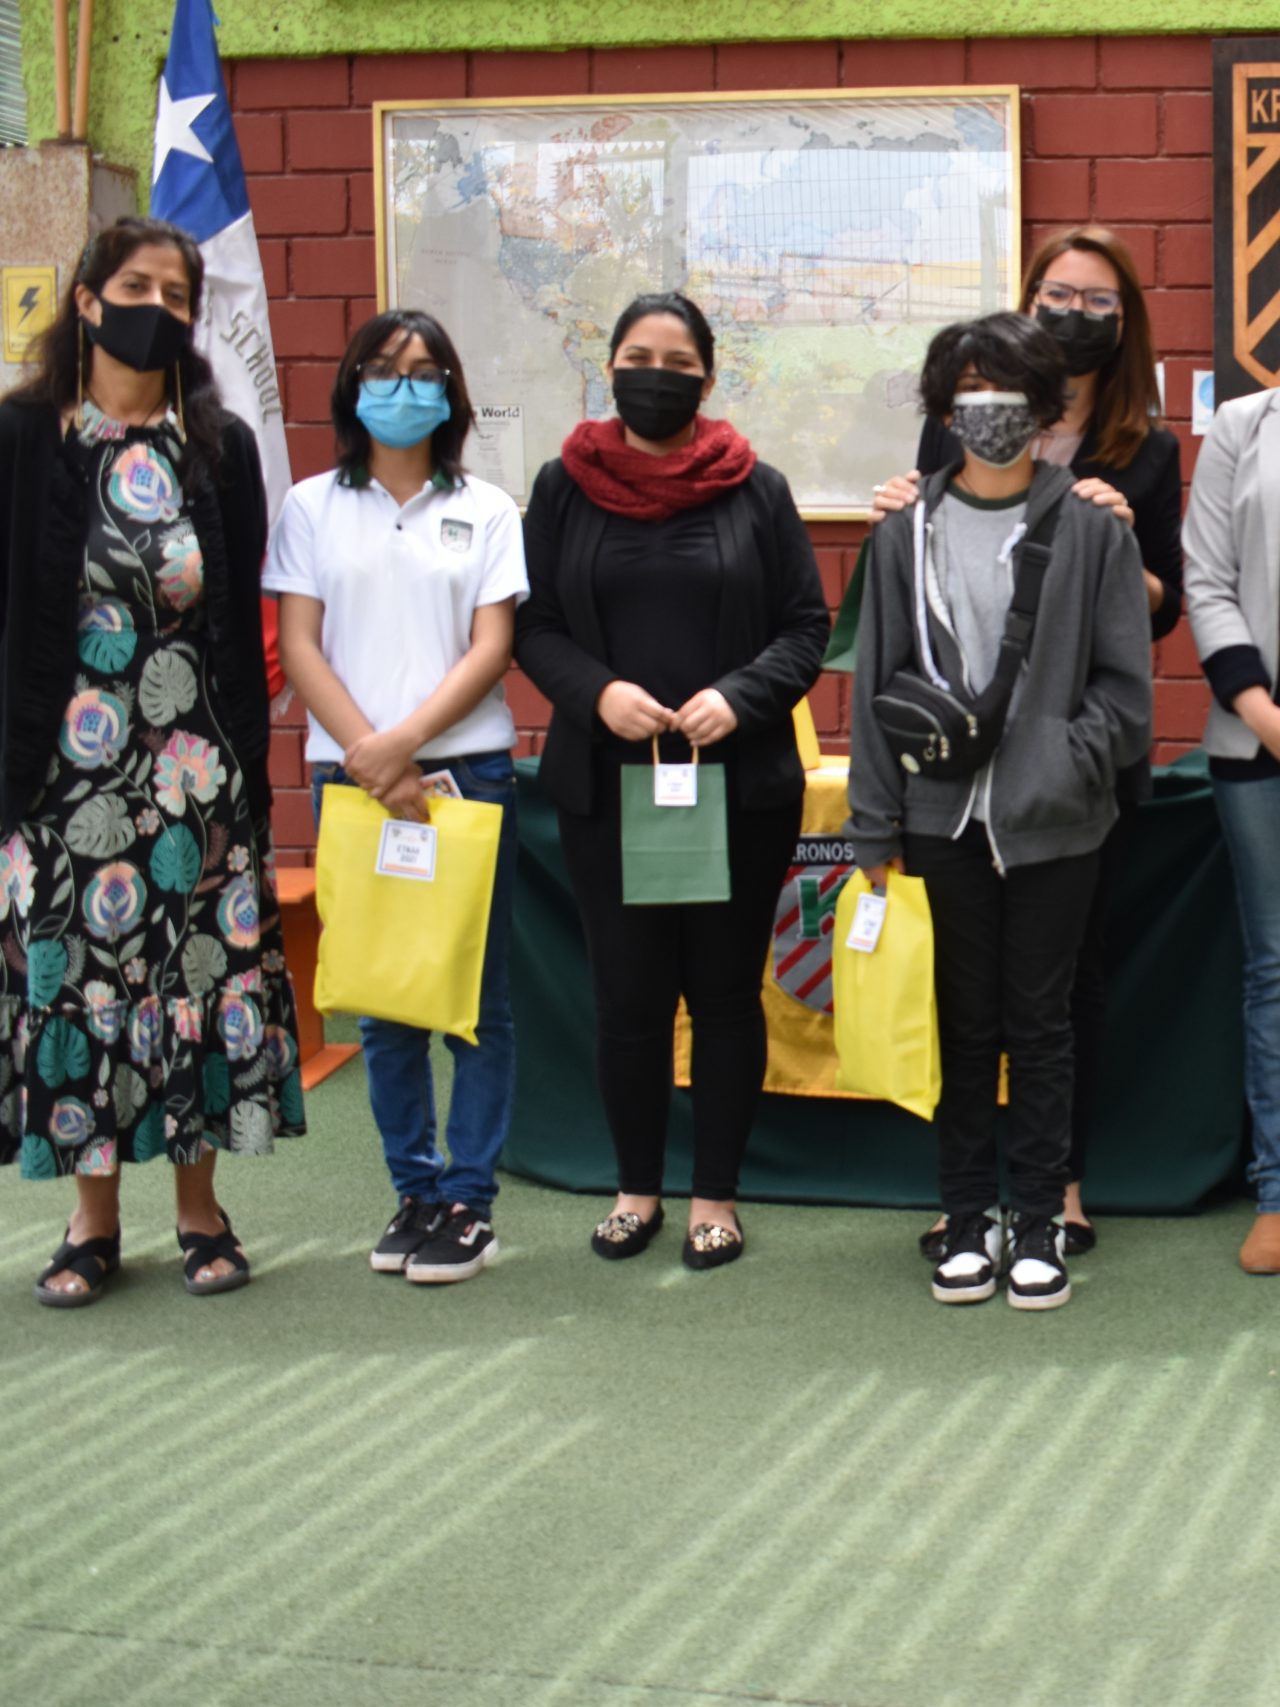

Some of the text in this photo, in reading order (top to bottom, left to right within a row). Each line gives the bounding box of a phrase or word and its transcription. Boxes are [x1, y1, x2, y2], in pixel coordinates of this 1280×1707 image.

[220, 310, 282, 424] SCHOOL
[481, 407, 520, 418] World
[792, 842, 855, 861] RONOS
